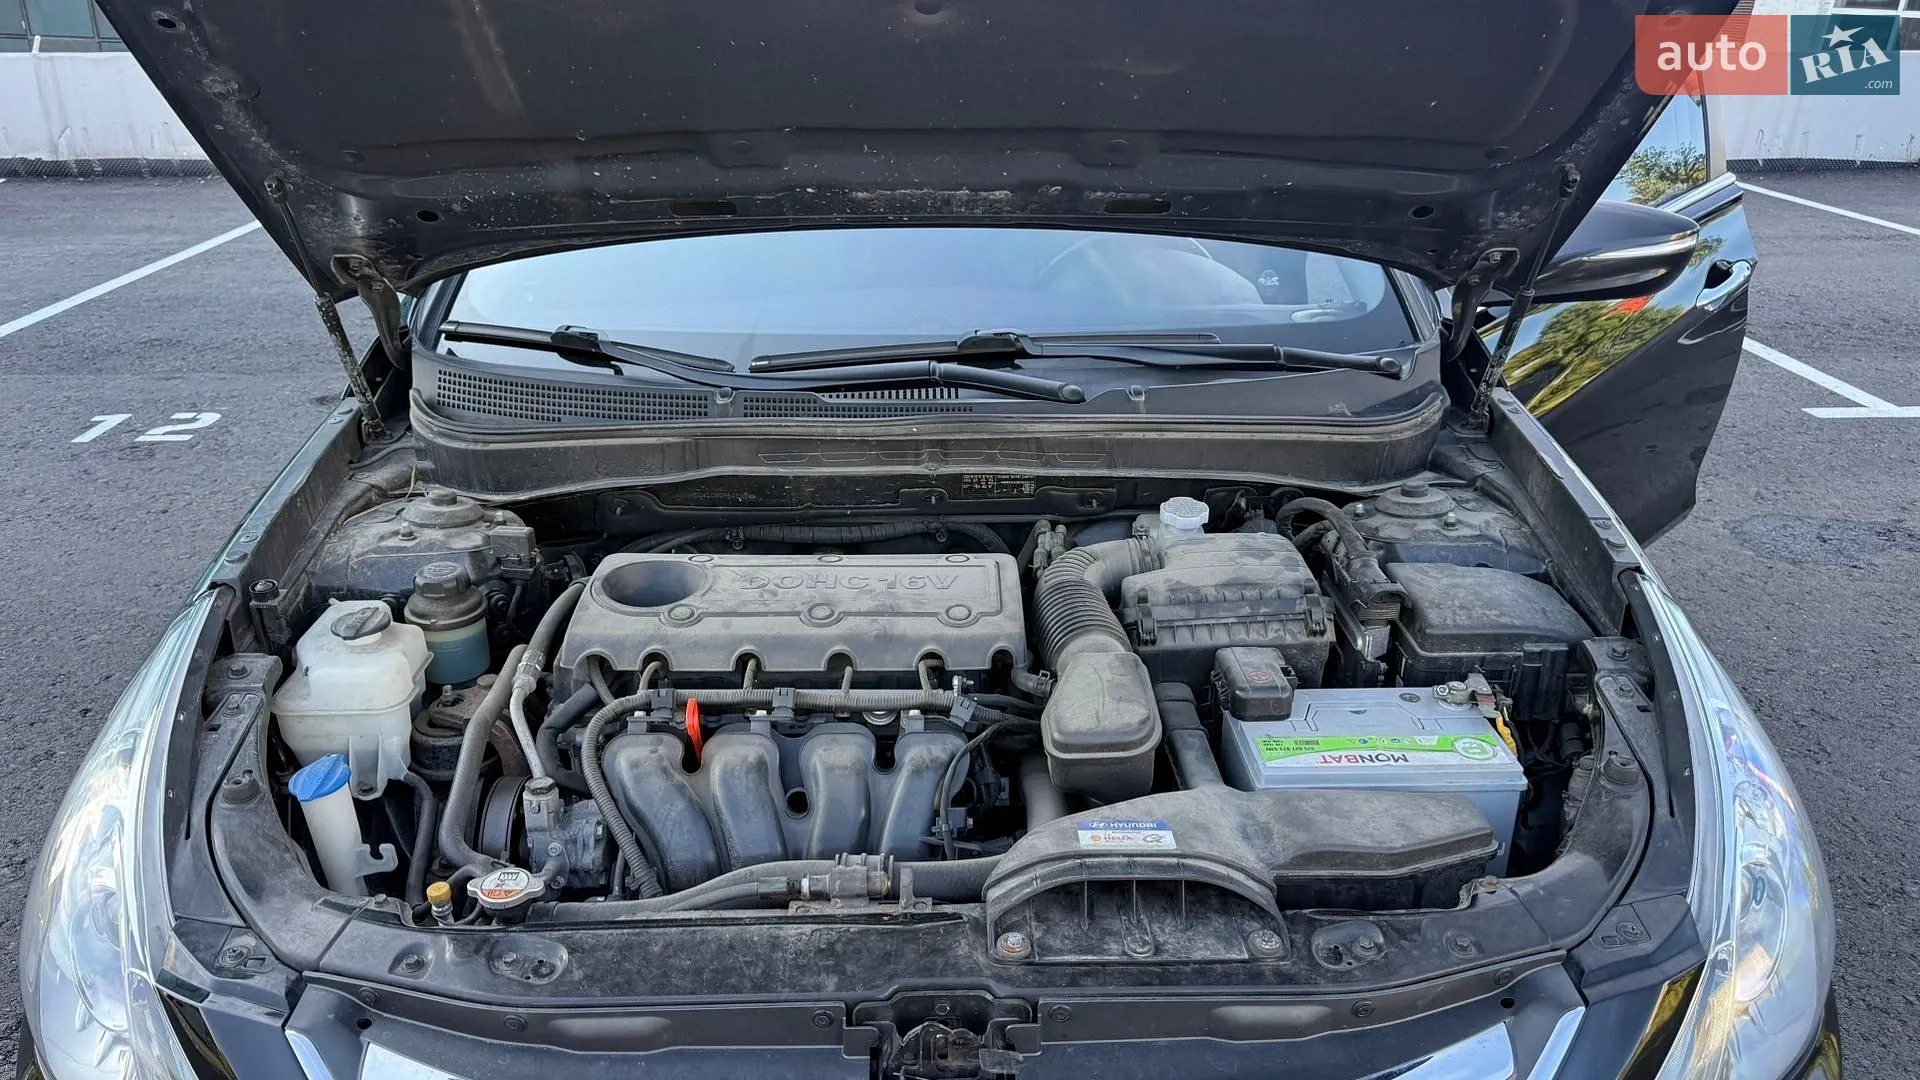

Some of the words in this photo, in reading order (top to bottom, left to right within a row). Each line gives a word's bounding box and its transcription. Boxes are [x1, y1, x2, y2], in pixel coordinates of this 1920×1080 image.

[71, 412, 222, 443] 12
[740, 574, 869, 590] DOHC
[879, 574, 959, 590] 16V
[1320, 753, 1409, 764] MONBAT
